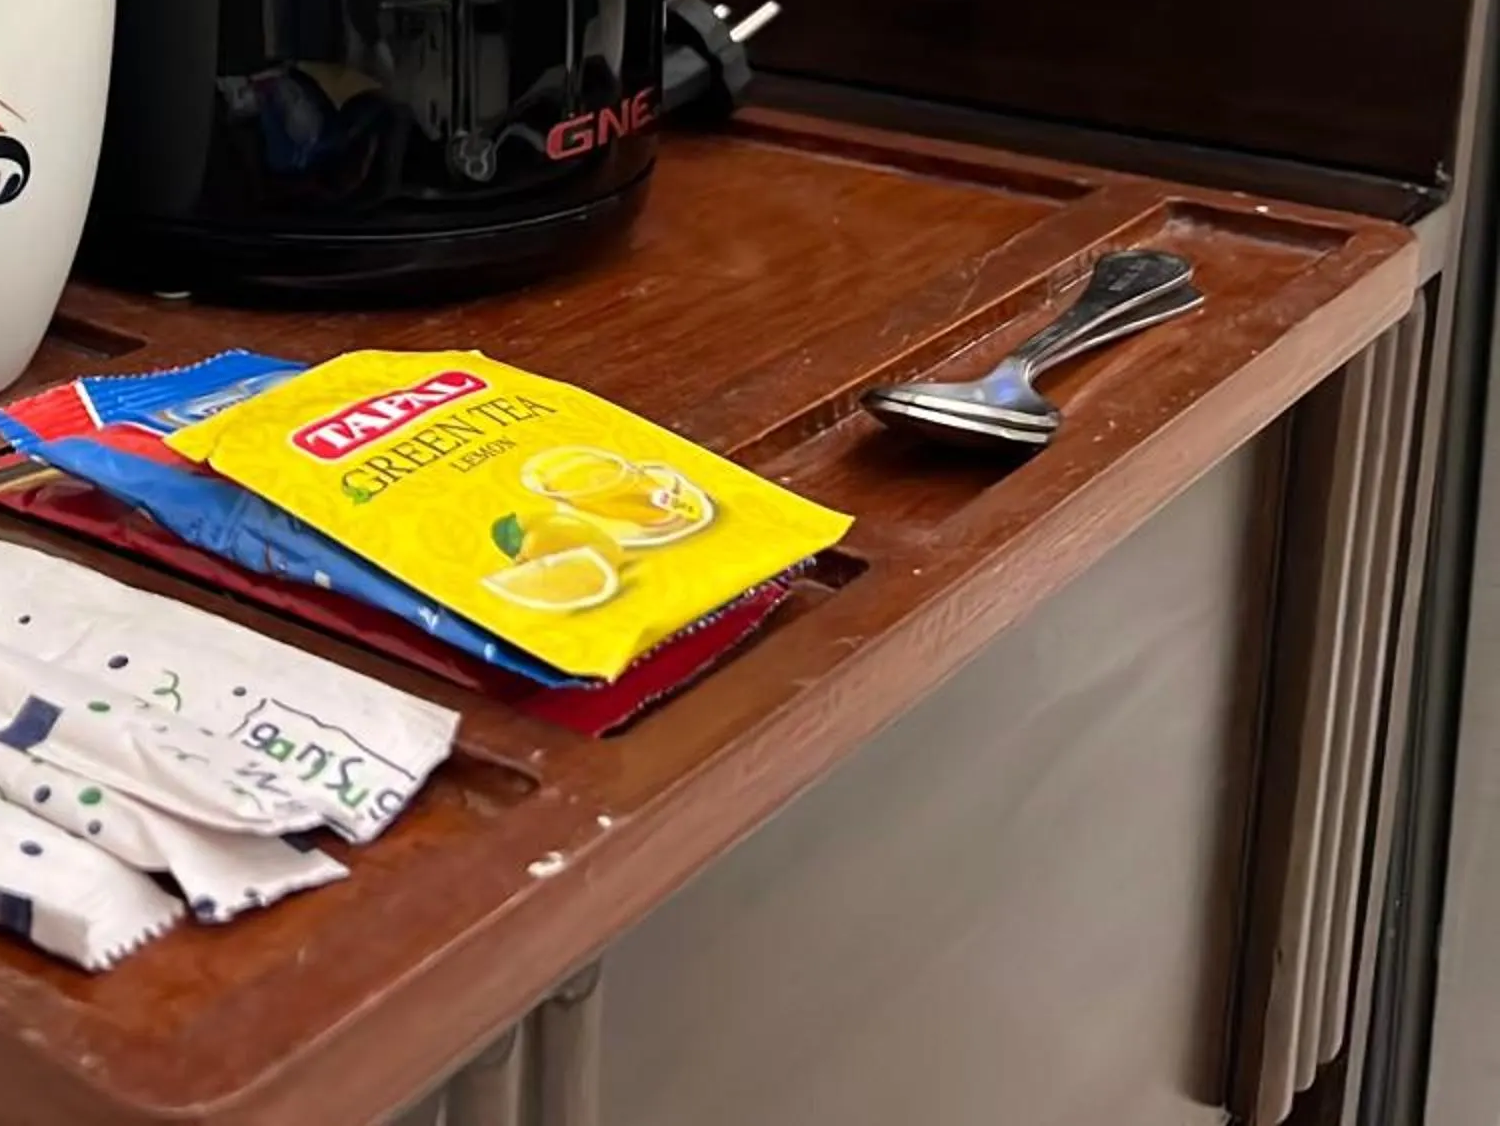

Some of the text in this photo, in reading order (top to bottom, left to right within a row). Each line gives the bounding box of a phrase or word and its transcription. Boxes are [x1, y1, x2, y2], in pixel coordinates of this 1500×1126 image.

[305, 377, 476, 451] TAPAL
[341, 394, 558, 498] GREEN TEA
[449, 437, 518, 473] LEMON
